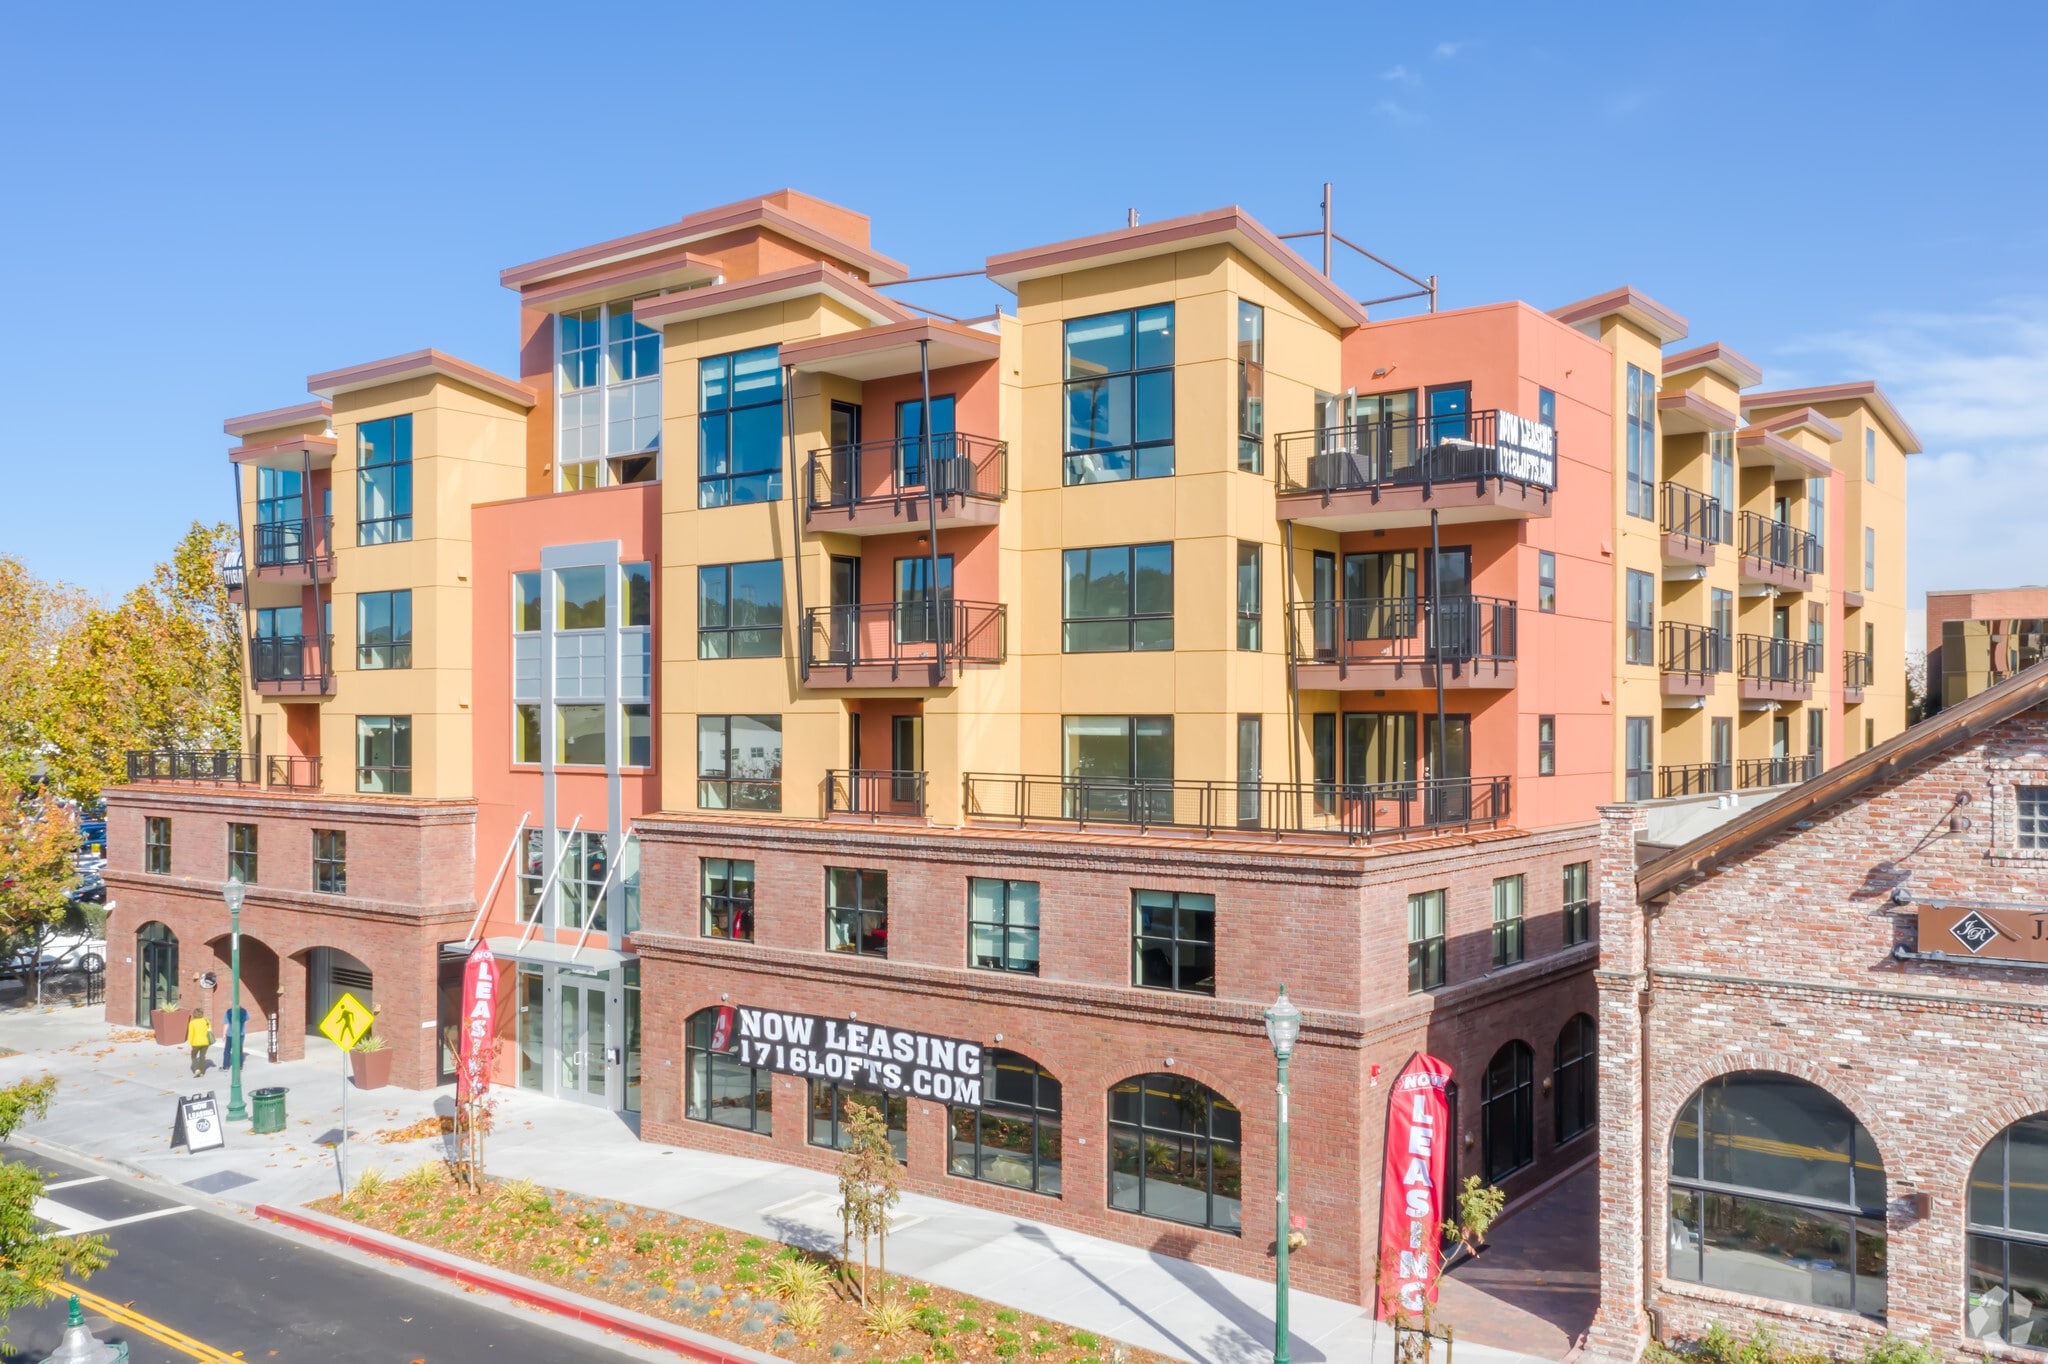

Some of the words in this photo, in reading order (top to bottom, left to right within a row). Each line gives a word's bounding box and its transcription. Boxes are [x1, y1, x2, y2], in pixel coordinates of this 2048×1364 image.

[1500, 410, 1519, 445] NOW
[1520, 418, 1552, 456] LEASING
[739, 1008, 814, 1046] NOW
[825, 1020, 981, 1075] LEASING
[740, 1039, 981, 1106] 1716LOFTS.COM
[1404, 1073, 1443, 1089] NOW
[1400, 1094, 1433, 1311] LEASING
